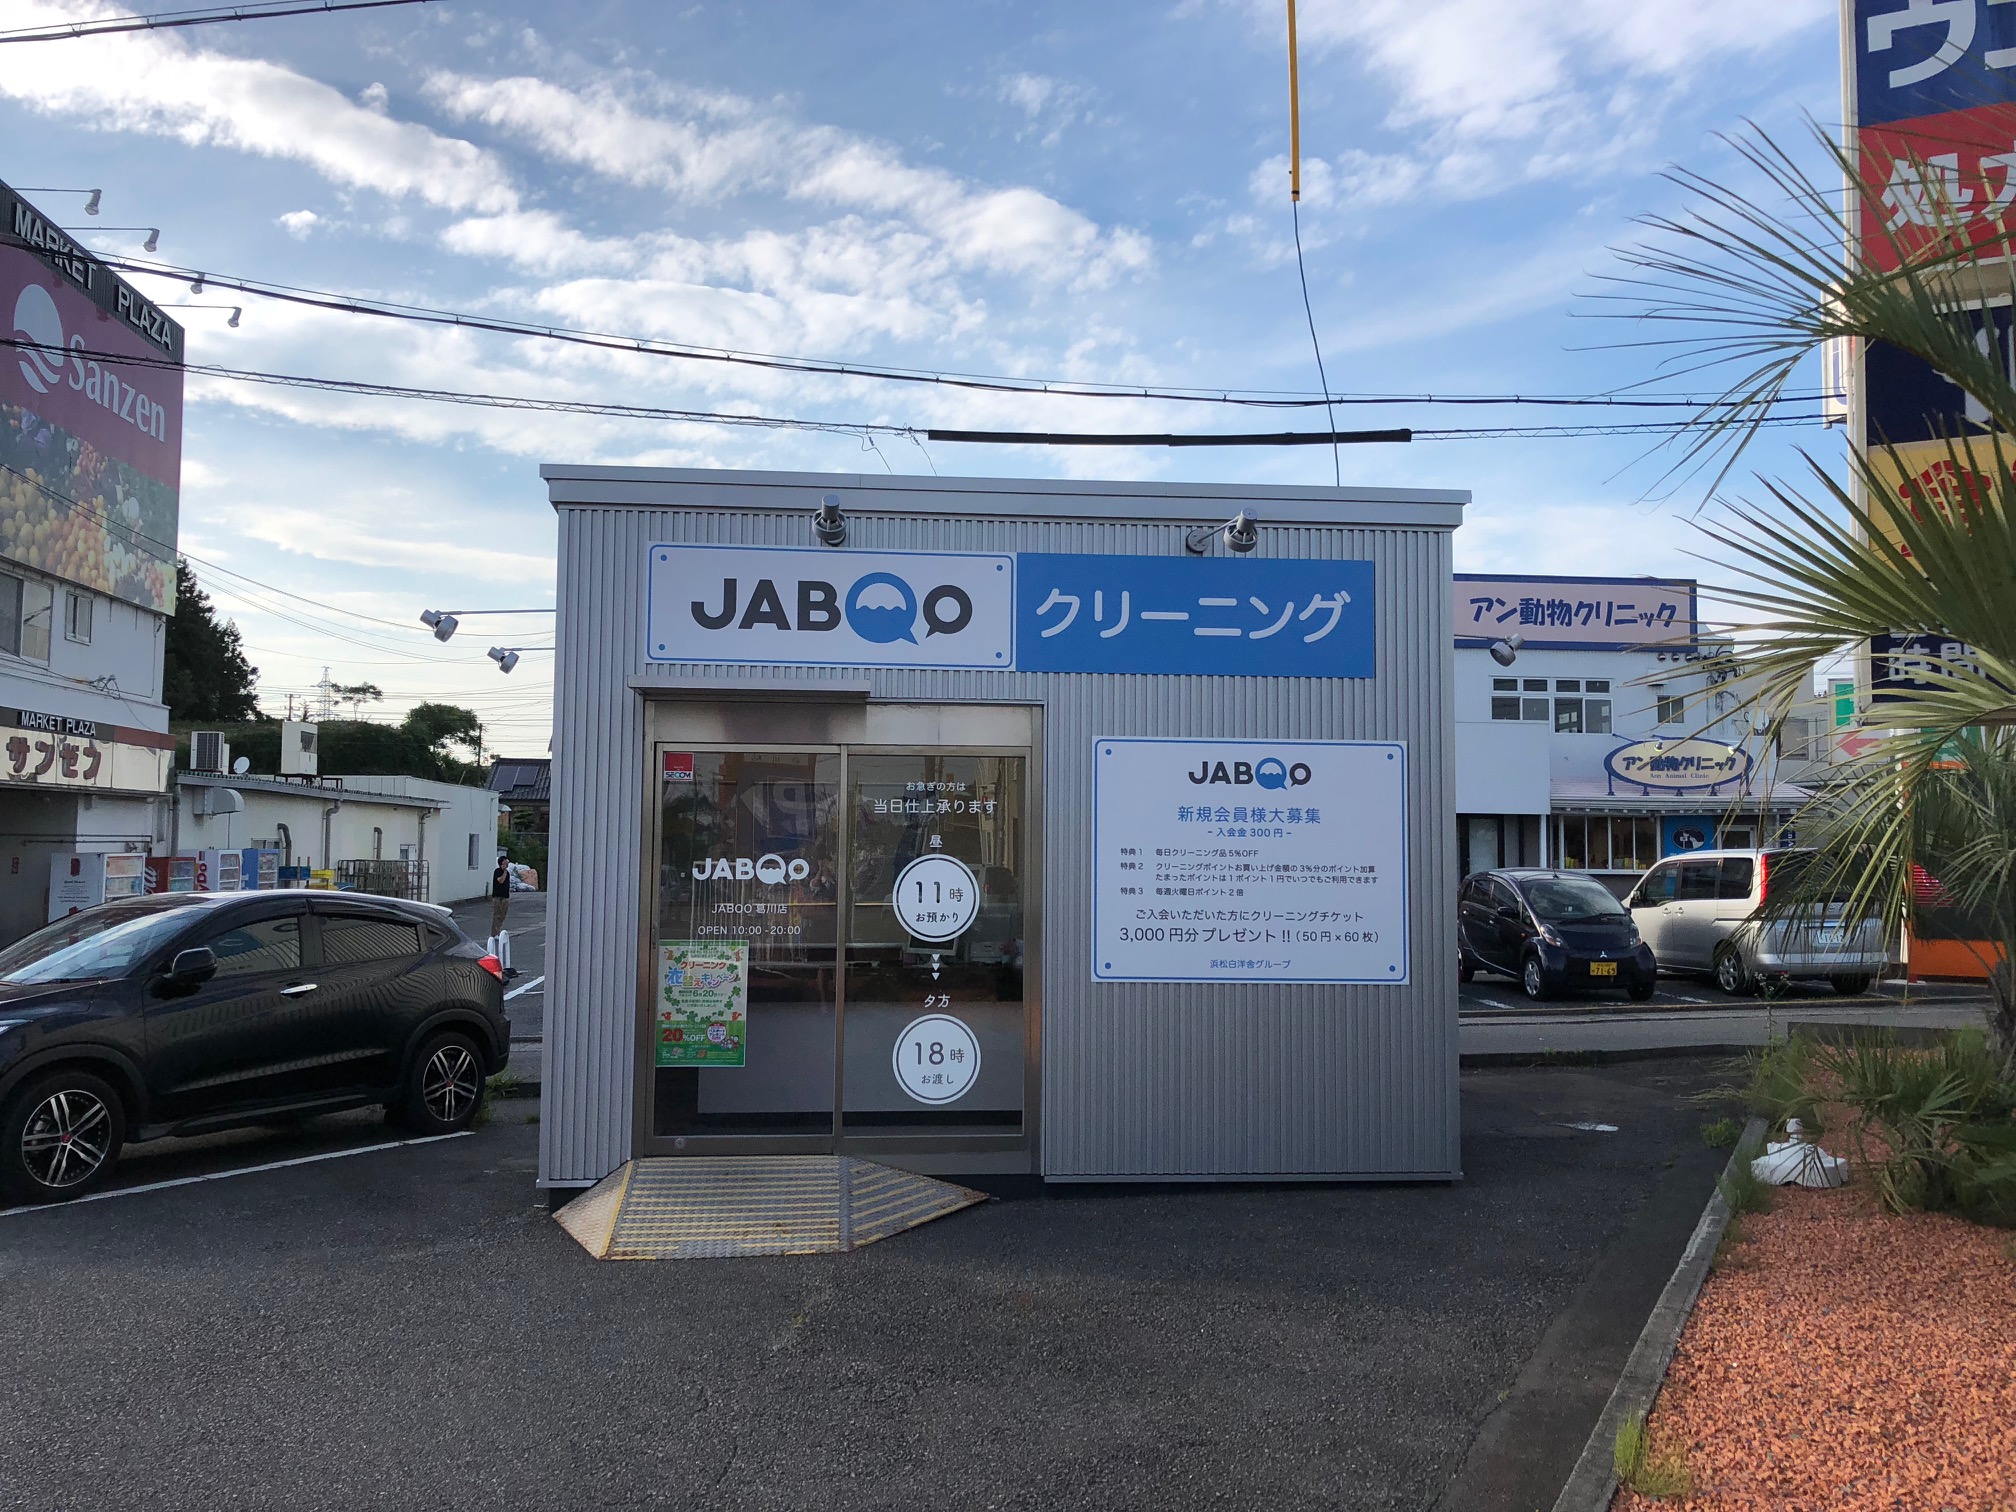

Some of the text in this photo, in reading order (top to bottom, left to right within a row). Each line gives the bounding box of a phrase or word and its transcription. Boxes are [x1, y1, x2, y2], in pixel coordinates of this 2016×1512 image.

[1867, 0, 2016, 88] ウ
[15, 202, 172, 351] MARKET PLAZA
[69, 334, 165, 443] Sanzen
[1035, 587, 1351, 643] クリーニング
[1469, 597, 1677, 628] アン動物クリニック
[21, 711, 96, 736] MARKET PLAZA
[6, 736, 101, 780] サンゼン
[1622, 756, 1737, 771] アン動物クリニック
[905, 781, 966, 792] お急ぎの方は
[873, 798, 998, 814] 当日仕上承ります
[1177, 805, 1321, 824] 新規会員様大募集
[929, 834, 942, 847] 昼
[711, 904, 788, 914] JABOO 葛川店
[1136, 908, 1363, 923] ご入会いただいた方にクリーニングチケット
[915, 911, 960, 923] お預かり
[697, 925, 728, 935] OPEN
[732, 925, 762, 935] 10:00
[1209, 959, 1292, 969] 浜松白洋舎グループ
[924, 993, 950, 1008] 夕方
[921, 1073, 954, 1085] お渡し
